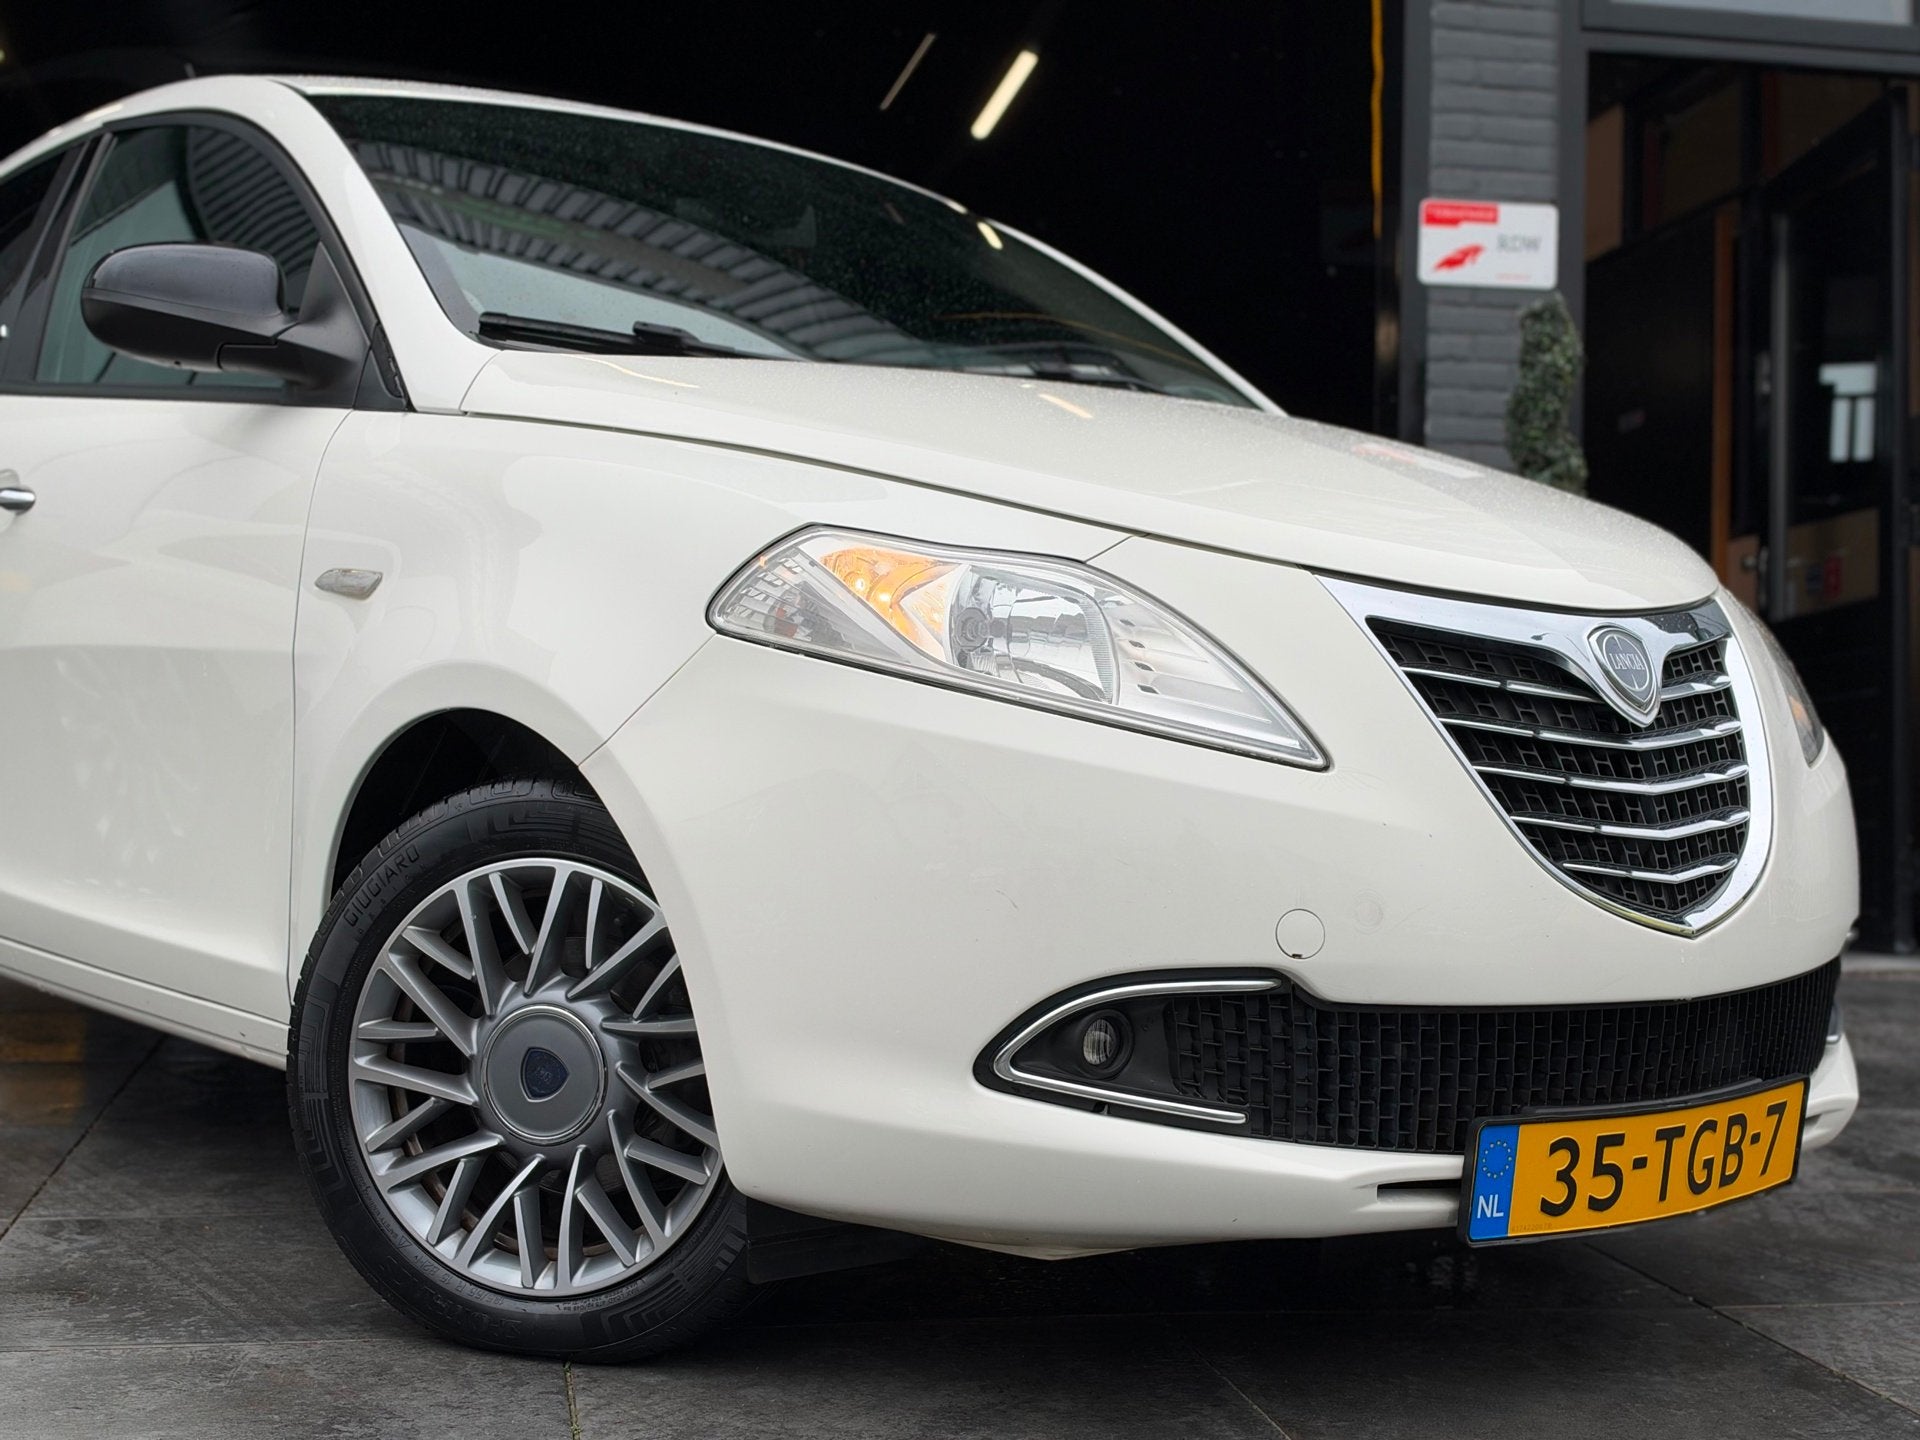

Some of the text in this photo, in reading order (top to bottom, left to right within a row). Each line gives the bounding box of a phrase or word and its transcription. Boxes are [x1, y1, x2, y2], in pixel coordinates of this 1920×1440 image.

[1609, 653, 1645, 670] LANCIA
[343, 844, 420, 927] GIUGIARO
[1540, 1100, 1787, 1217] 35-TGB-7
[1477, 1194, 1504, 1219] NL
